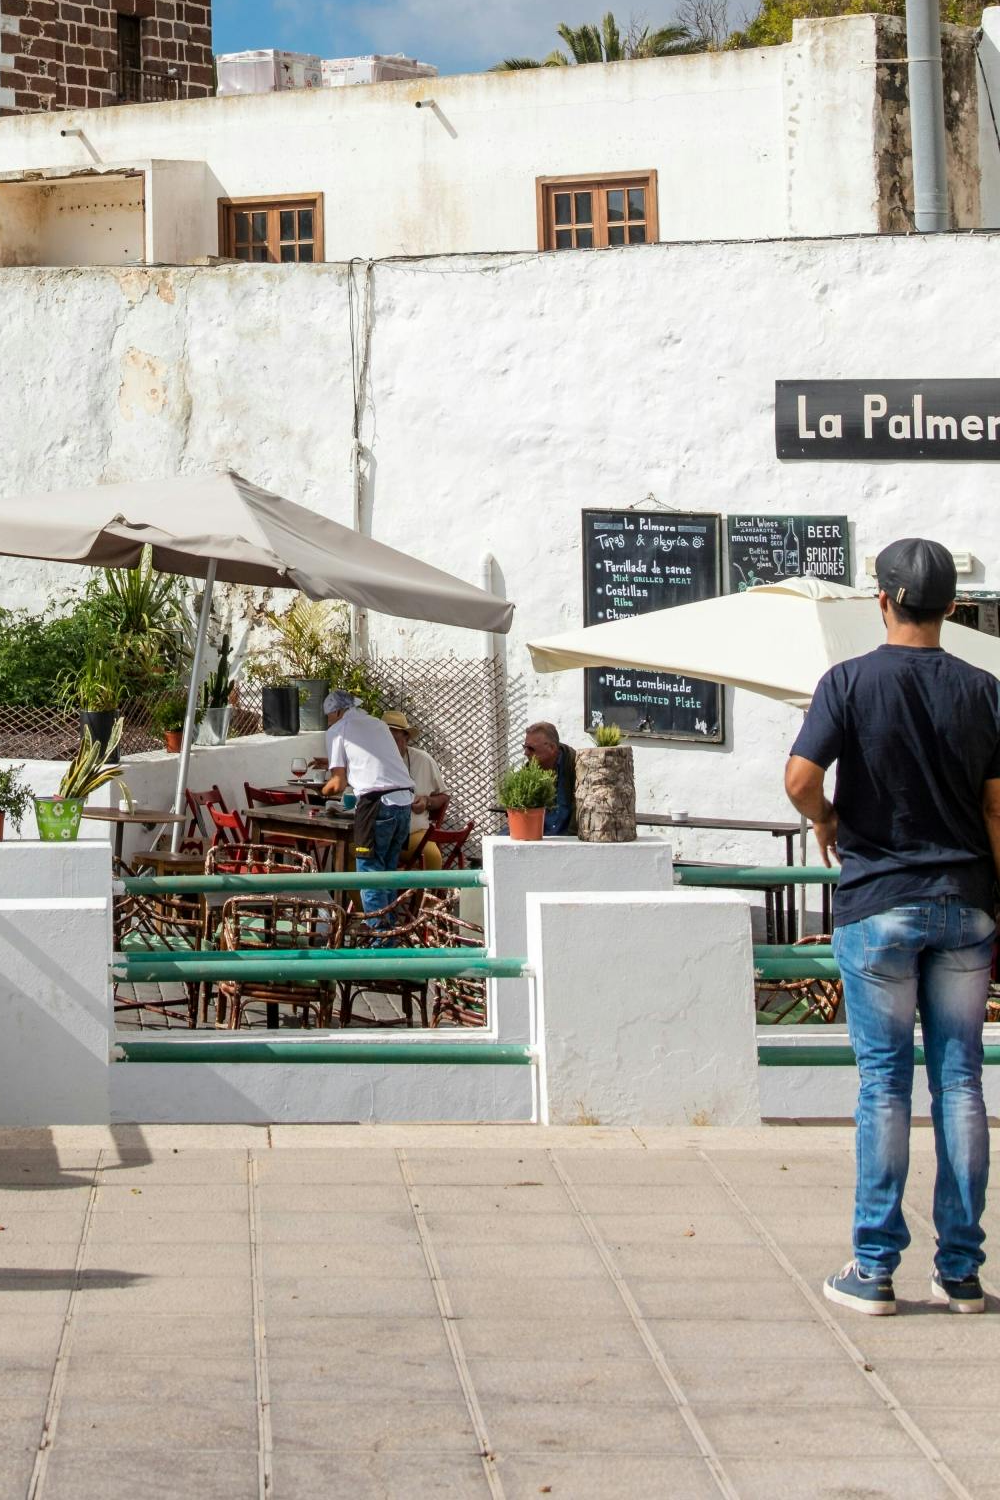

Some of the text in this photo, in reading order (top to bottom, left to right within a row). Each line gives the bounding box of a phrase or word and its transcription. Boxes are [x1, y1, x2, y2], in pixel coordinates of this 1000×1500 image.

[797, 394, 1000, 441] La Palmer
[624, 517, 676, 532] La Palmera
[735, 517, 754, 527] Local
[808, 526, 842, 538] BEER
[595, 534, 625, 550] Tapas
[636, 534, 645, 546] &
[806, 547, 844, 562] SPIRITS
[604, 560, 692, 575] Parrillada de carne
[605, 584, 649, 597] Costillas
[605, 674, 692, 693] Plato combinado
[675, 696, 702, 709] Plate
